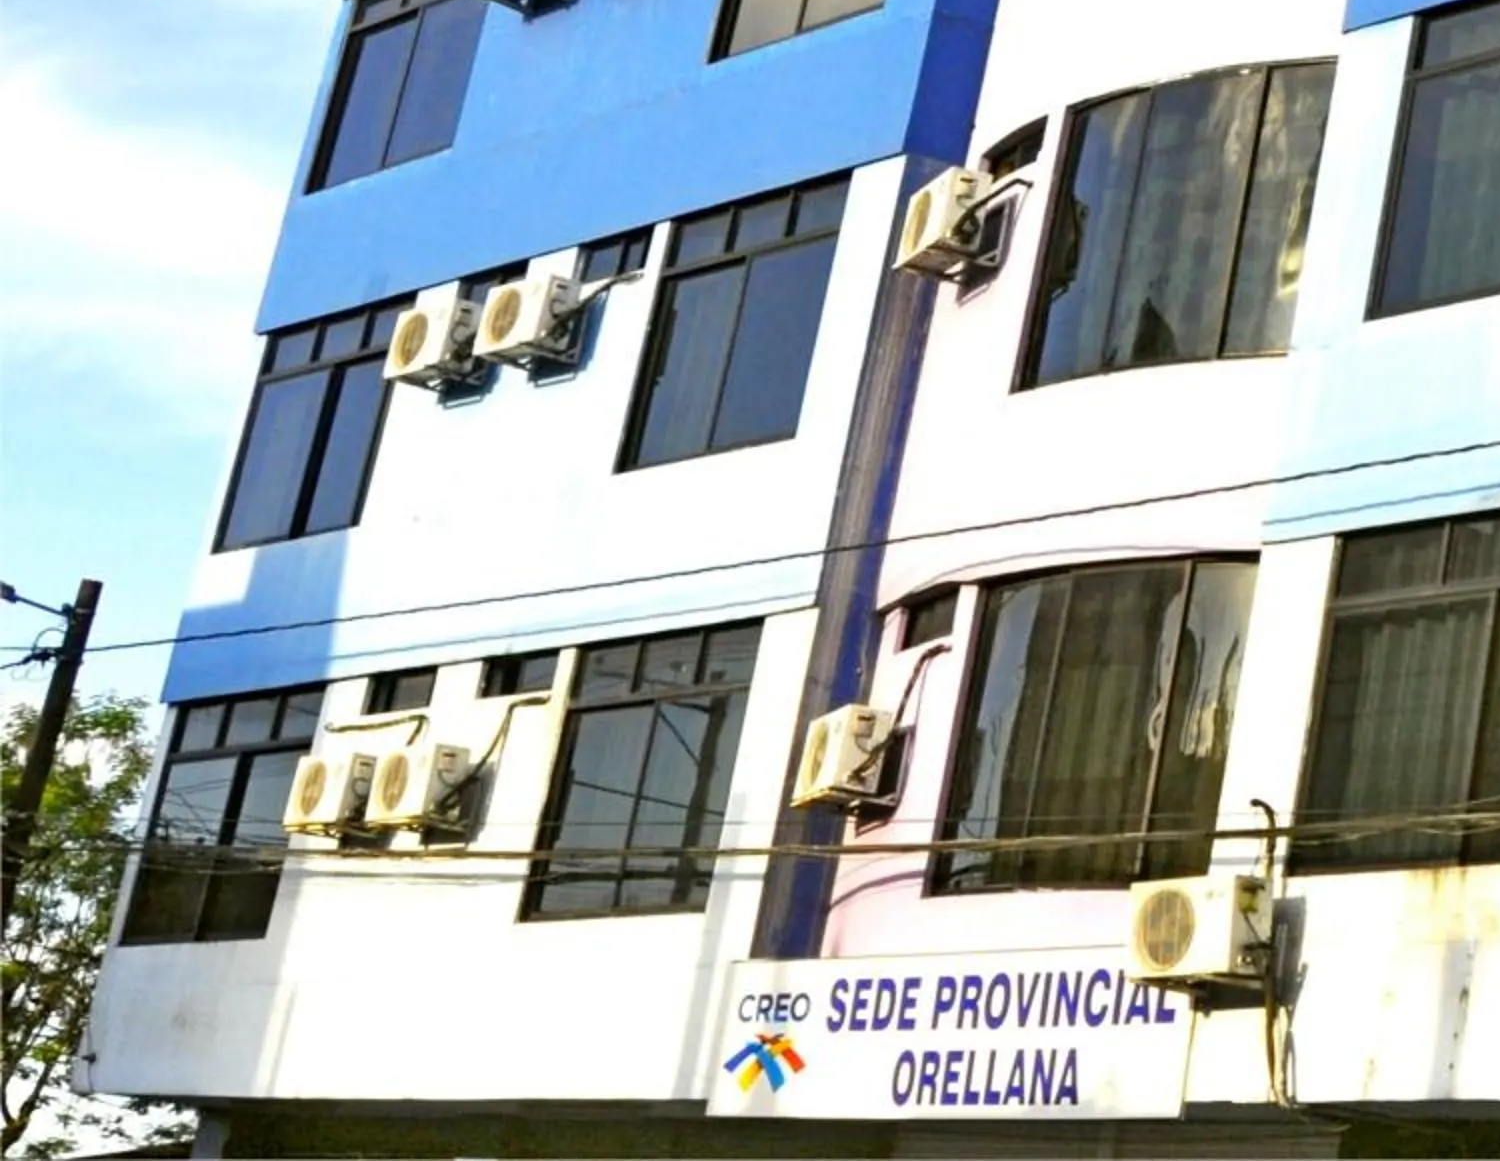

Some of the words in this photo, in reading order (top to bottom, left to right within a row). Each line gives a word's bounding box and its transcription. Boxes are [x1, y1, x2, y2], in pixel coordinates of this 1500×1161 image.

[738, 992, 811, 1024] CREO
[826, 976, 923, 1033] SEDE
[931, 968, 1177, 1030] PROVINCIAL
[891, 1047, 1079, 1106] ORELLANA
